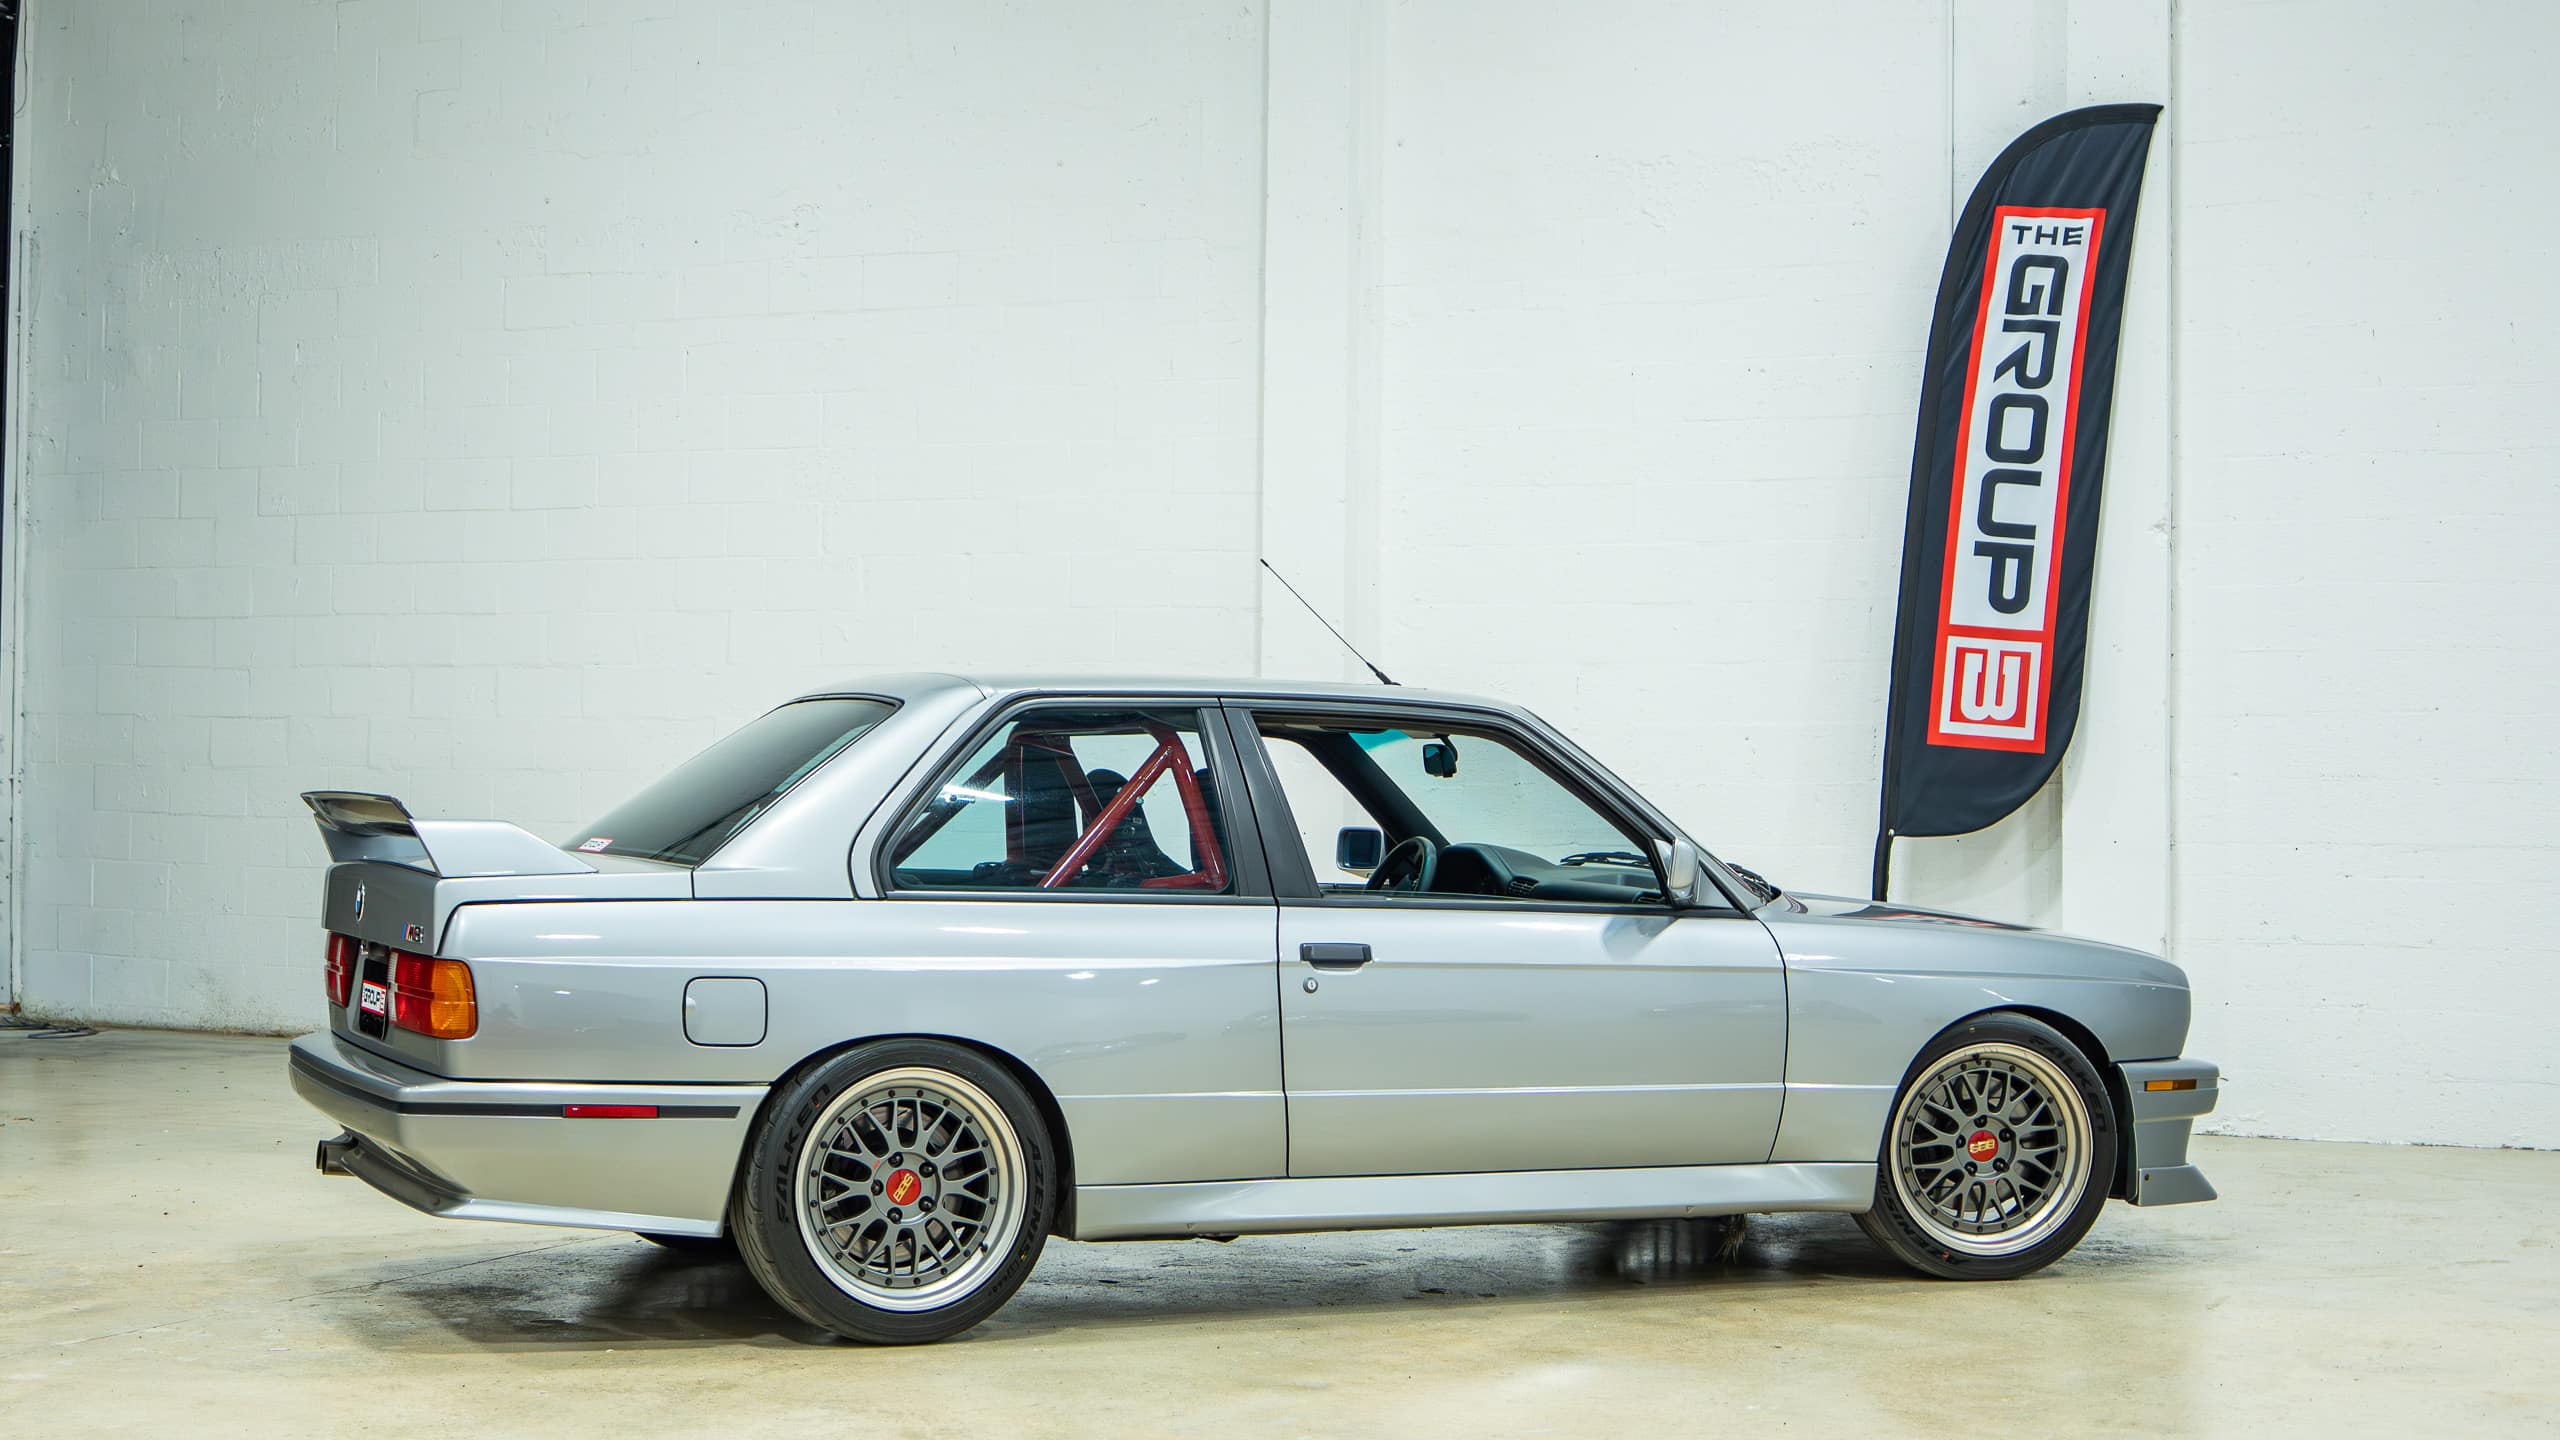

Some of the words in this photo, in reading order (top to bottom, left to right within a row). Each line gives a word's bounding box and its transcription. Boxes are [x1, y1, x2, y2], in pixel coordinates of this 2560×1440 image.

[2012, 225, 2084, 246] THE
[1973, 254, 2069, 615] GROUP
[1970, 1138, 1994, 1154] BBS
[893, 1173, 914, 1202] BBS
